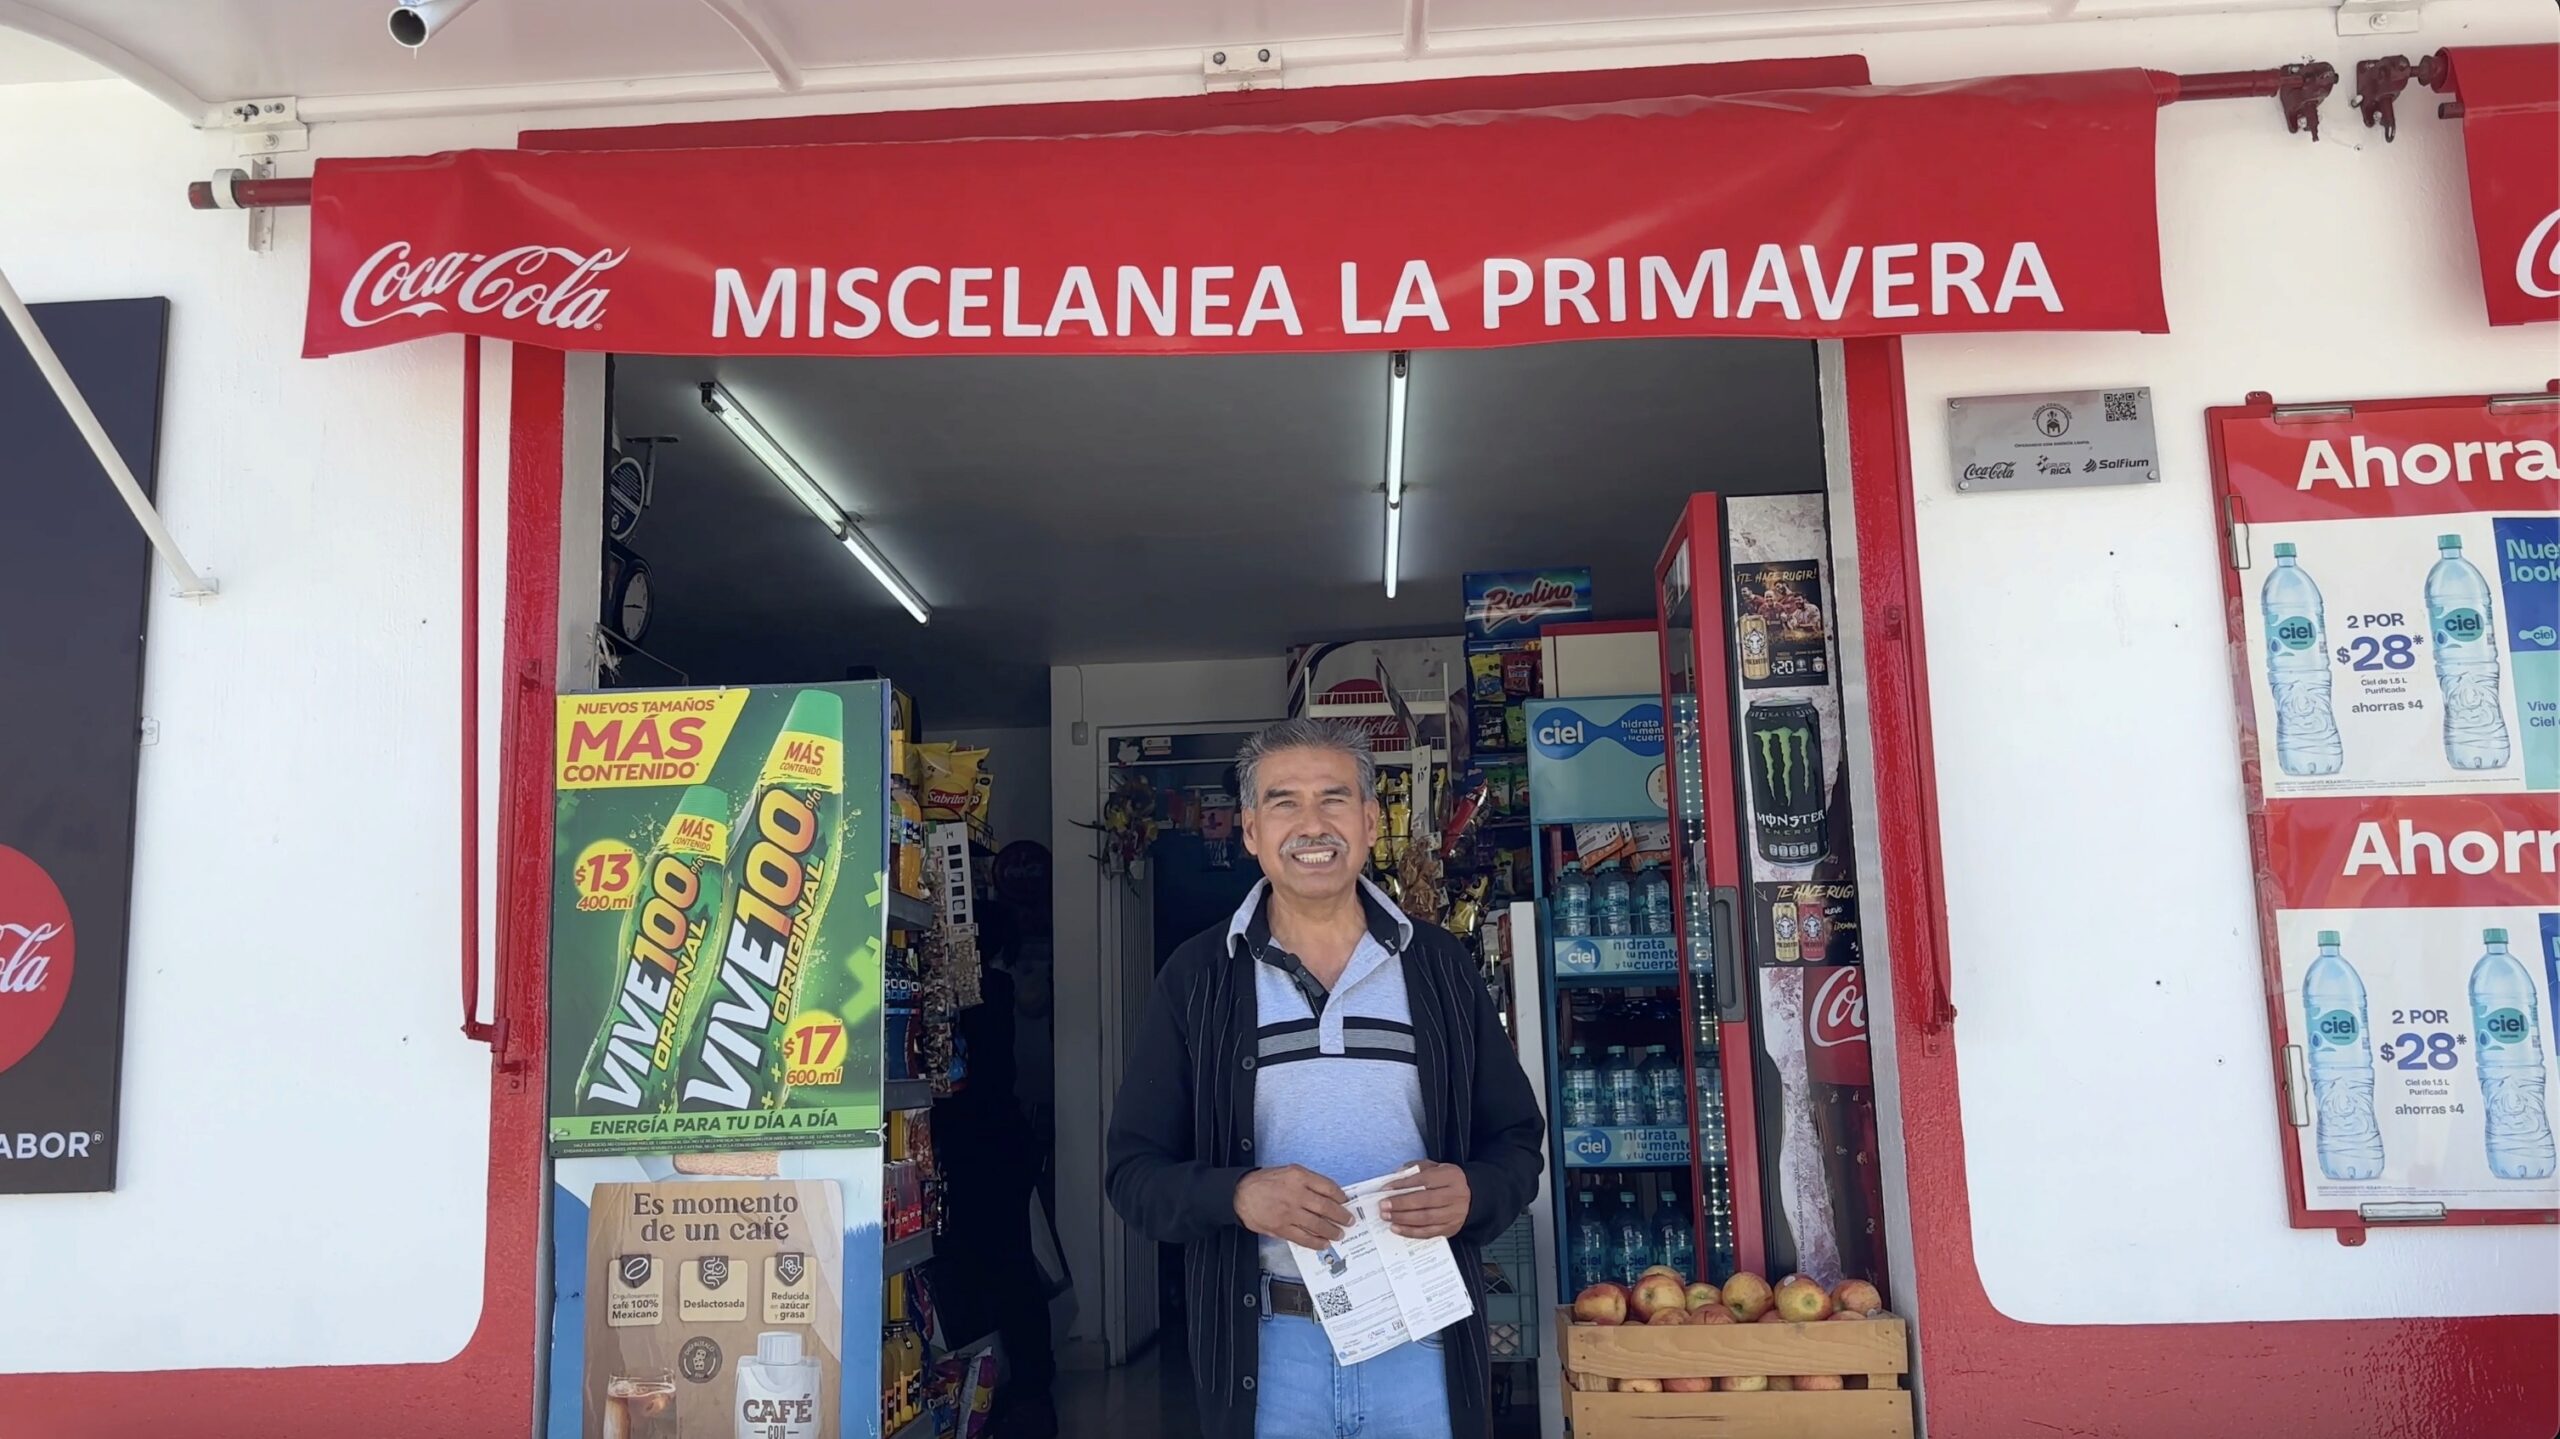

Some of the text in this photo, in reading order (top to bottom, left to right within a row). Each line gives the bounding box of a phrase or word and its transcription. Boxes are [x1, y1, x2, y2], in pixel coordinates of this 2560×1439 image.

[340, 241, 631, 331] Coca-Cola
[712, 242, 2065, 339] MISCELANEA LA PRIMAVERA
[1964, 461, 2016, 480] Coca-Cola
[2099, 458, 2149, 469] Solfium
[2505, 539, 2560, 560] Nue
[1755, 571, 1779, 584] HACE
[1782, 567, 1817, 581] RUGIR!
[1484, 579, 1574, 630] Ricolino
[2347, 613, 2404, 629] 2 POR
[2445, 615, 2482, 632] ciel
[2278, 623, 2313, 640] ciel
[2533, 630, 2554, 640] ciel
[1771, 660, 1795, 675] $20
[2361, 678, 2376, 686] Ciel
[2364, 686, 2406, 695] Purificada
[577, 699, 715, 713] NUEVOS TAMAÑOS
[2351, 699, 2424, 714] ahorras $4
[2527, 702, 2557, 712] Vive
[1621, 720, 1659, 729] hidrata
[2530, 717, 2555, 727] Ciel
[566, 715, 706, 762] MÁS
[1538, 719, 1584, 745] ciel
[784, 740, 824, 765] MÁS
[779, 762, 821, 776] CONTENIDO
[1756, 809, 1825, 828] MONSTER
[677, 819, 713, 842] MÁS
[1765, 826, 1819, 836] ENERGY
[673, 837, 711, 851] CONTENIDO
[574, 852, 631, 892] $13
[1777, 885, 1793, 900] TE
[1792, 884, 1827, 900] HACE
[577, 893, 634, 910] 400 ml
[1825, 906, 1843, 915] NUEVO
[773, 858, 826, 1025] ORIGINAL
[1568, 948, 1596, 964] ciel
[653, 919, 707, 1071] ORIGINAL
[2320, 1015, 2357, 1035] ciel
[2391, 1009, 2449, 1025] 2 POR
[2487, 1013, 2526, 1033] ciel
[783, 1025, 842, 1066] $17
[786, 1068, 843, 1085] 600 ml
[2405, 1078, 2420, 1086] Ciel
[2409, 1088, 2448, 1096] Purificada
[2394, 1103, 2465, 1115] ahorras $4
[590, 1110, 838, 1135] ENERGÍA PARA TU DÍA A DÍA
[1578, 1138, 1606, 1154] ciel
[633, 1193, 798, 1216] Es momento
[640, 1214, 790, 1242] de un café
[612, 1299, 659, 1310] café 100%
[684, 1299, 745, 1309] Deslactosada
[771, 1292, 810, 1301] Reducida
[779, 1301, 810, 1310] azúcar
[612, 1310, 658, 1319] Mexicano
[780, 1311, 805, 1320] grasa
[743, 1393, 813, 1423] CAFÉ
[767, 1425, 786, 1439] CON
